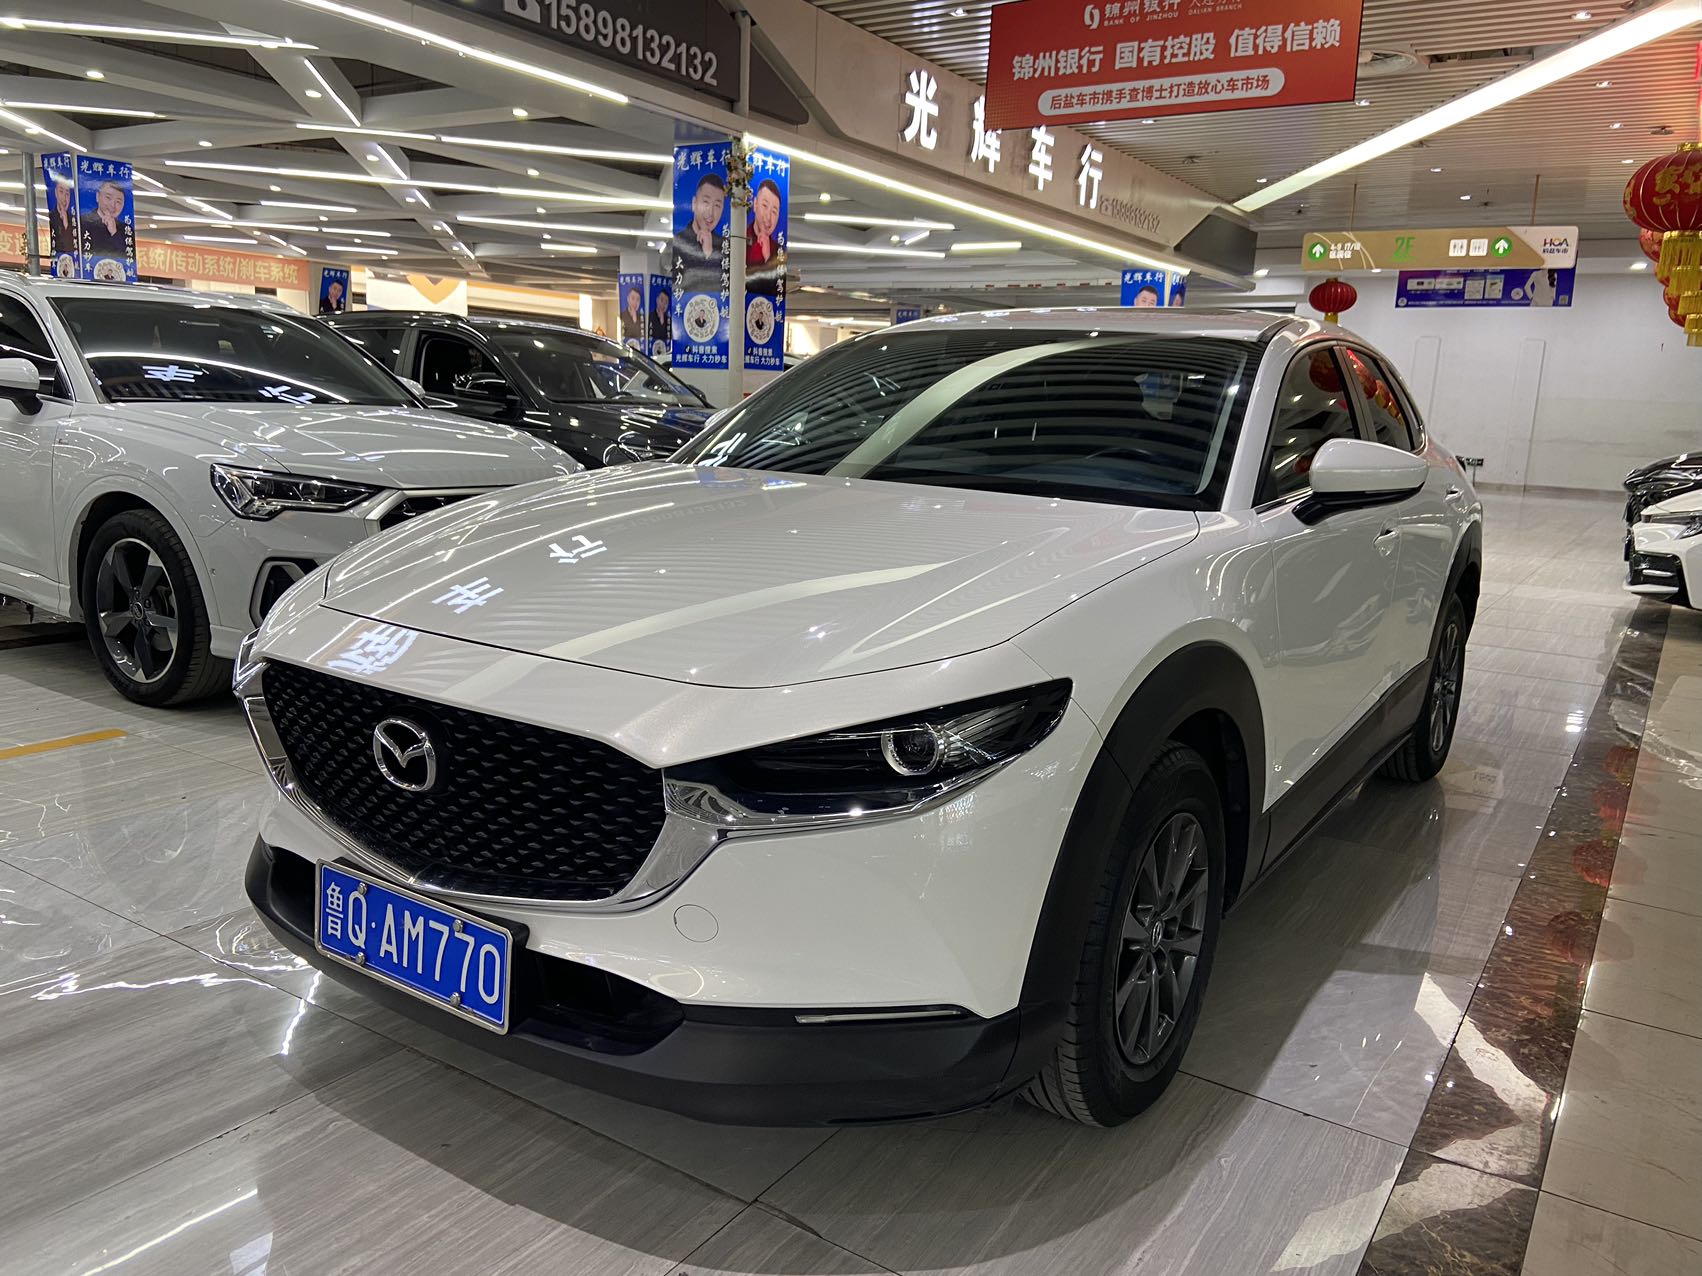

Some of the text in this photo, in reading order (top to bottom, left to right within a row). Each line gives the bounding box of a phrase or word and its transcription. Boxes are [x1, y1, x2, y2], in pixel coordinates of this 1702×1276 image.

[1103, 18, 1124, 27] BANK
[1129, 16, 1140, 24] OF
[1146, 11, 1179, 21] JINZHOU
[545, 0, 718, 87] 15898132132
[1012, 18, 1342, 80] 锦州银行 国有控股 值得信赖
[1049, 74, 1271, 110] 后盐车市携手查博士打造放心车市场
[1394, 236, 1416, 257] 2F
